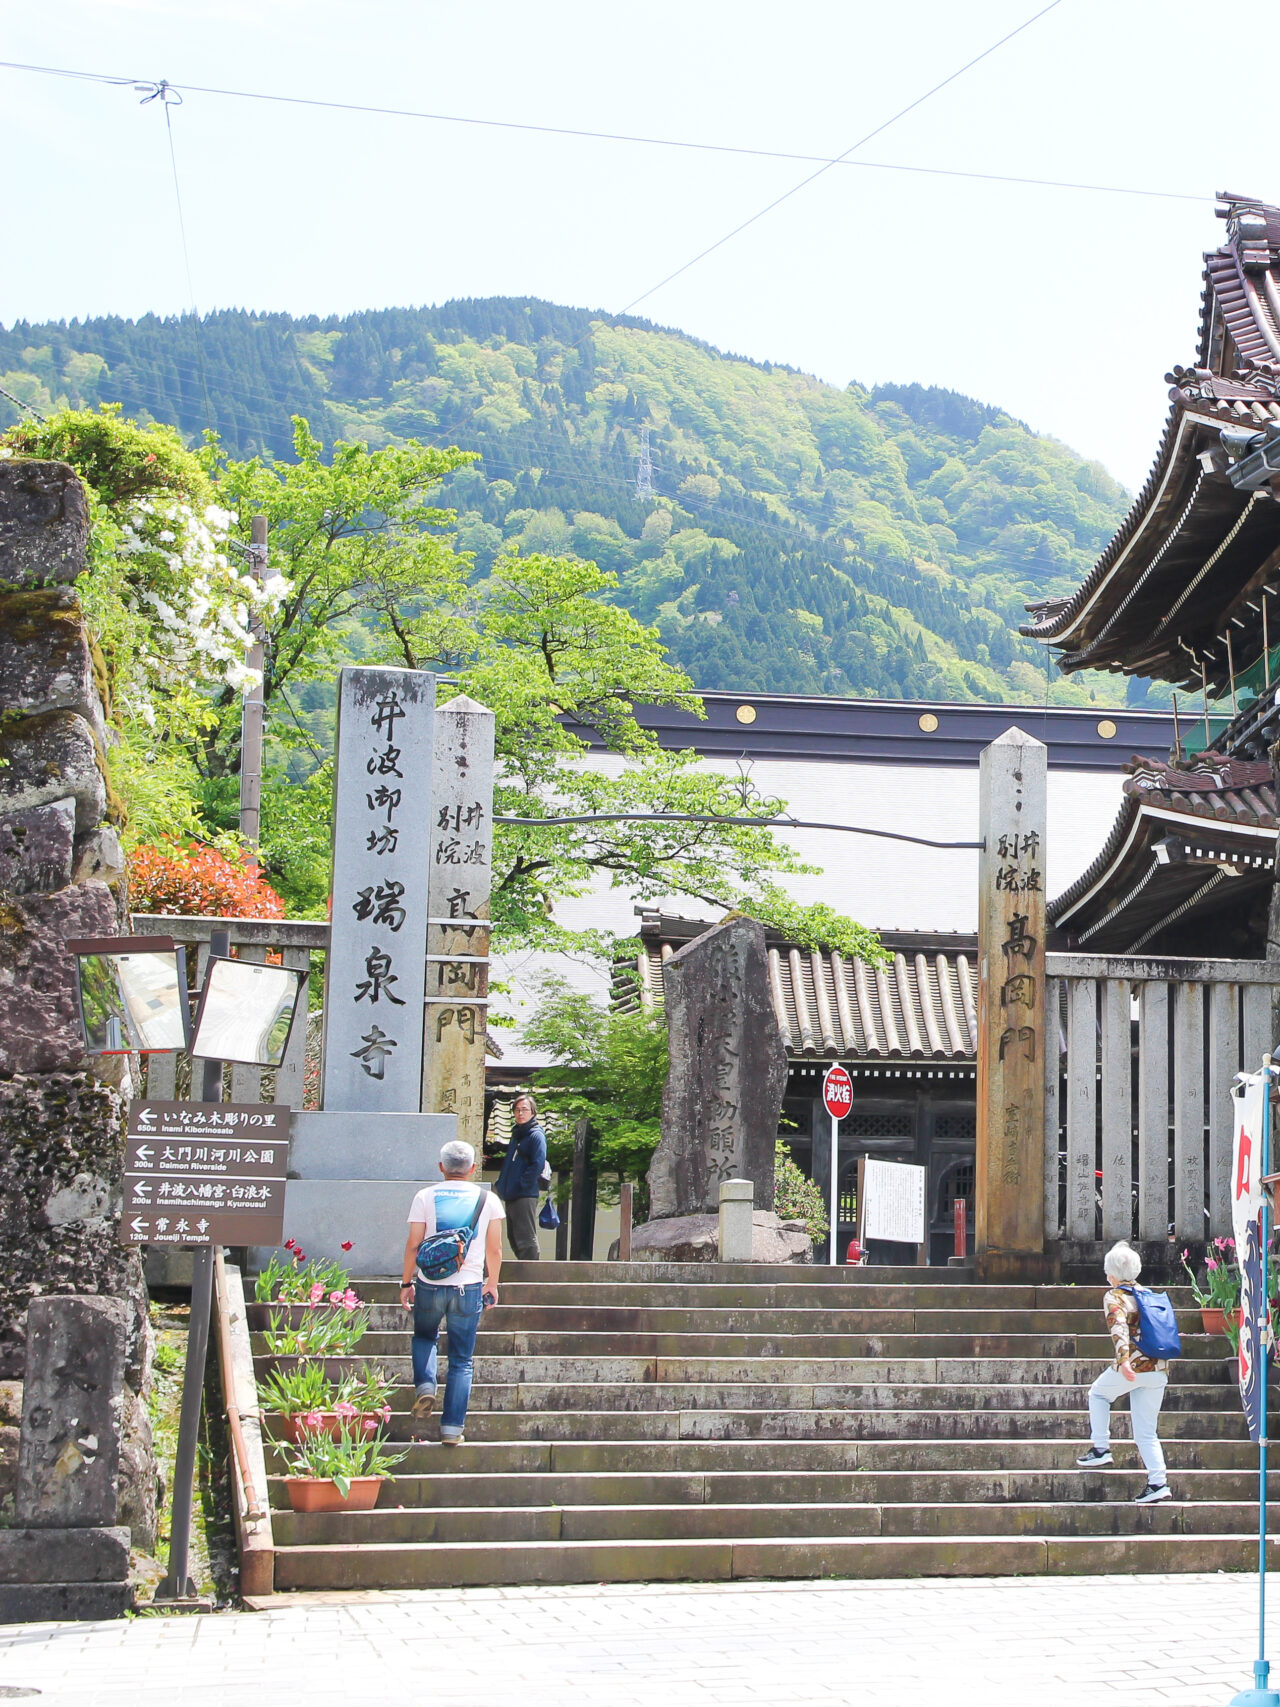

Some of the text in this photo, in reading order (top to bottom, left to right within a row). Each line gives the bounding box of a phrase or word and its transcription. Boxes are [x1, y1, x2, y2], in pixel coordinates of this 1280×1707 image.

[827, 1082, 851, 1104] 消火栓
[163, 1110, 277, 1128] いなみ木彫りの里
[161, 1125, 183, 1133] Inami
[184, 1126, 234, 1135] Kiborinosato
[160, 1145, 275, 1164] 大門川河川公園
[159, 1161, 189, 1170] Daimon
[190, 1162, 227, 1172] Riverside
[156, 1197, 225, 1209] Inamihachimangu
[226, 1199, 267, 1209] Kyurousui
[155, 1217, 210, 1234] 常永寺
[153, 1233, 180, 1242] Joueiji
[181, 1233, 210, 1242] Temple
